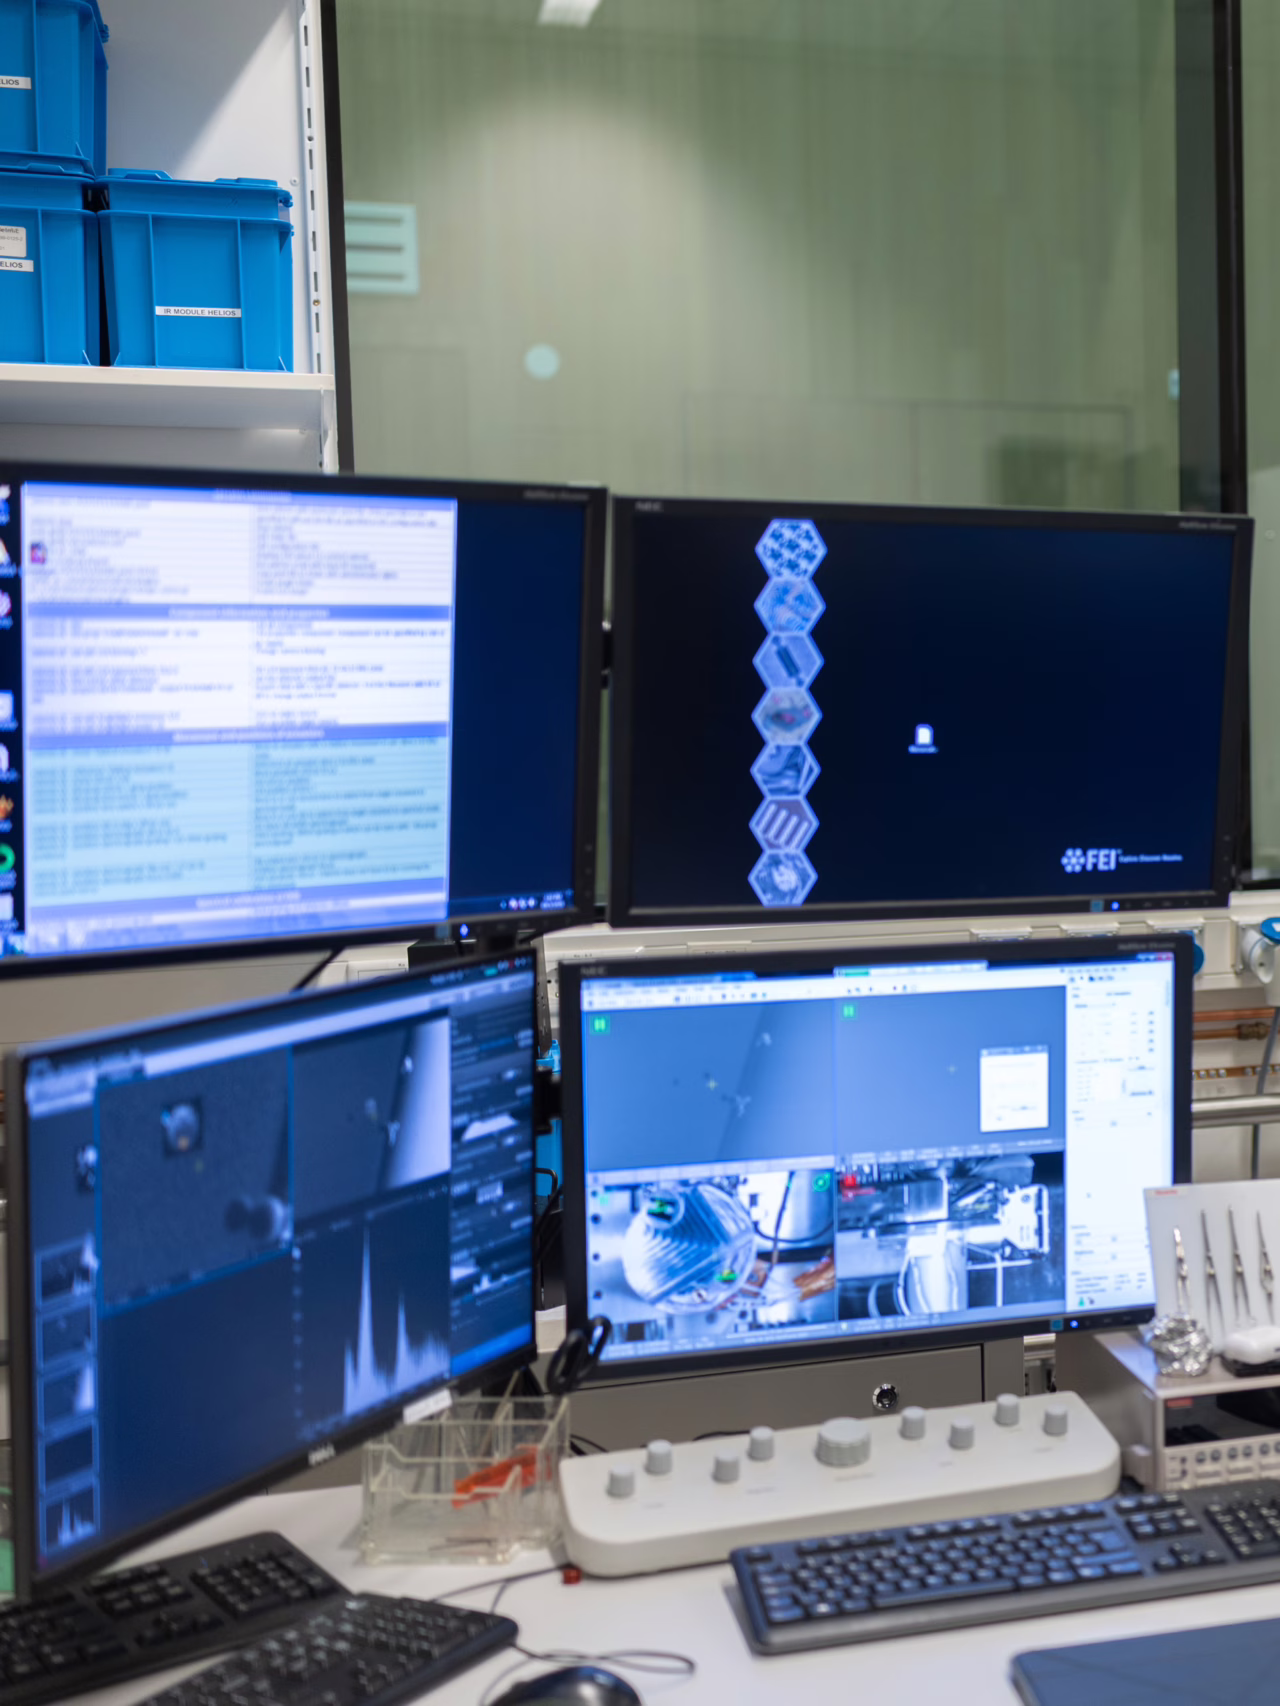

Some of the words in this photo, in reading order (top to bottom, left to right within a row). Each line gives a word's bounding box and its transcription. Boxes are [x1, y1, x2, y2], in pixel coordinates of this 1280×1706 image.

[0, 78, 20, 86] LIOS
[173, 308, 206, 316] MODULE
[207, 309, 237, 317] HELIOS
[1086, 847, 1117, 872] FEI
